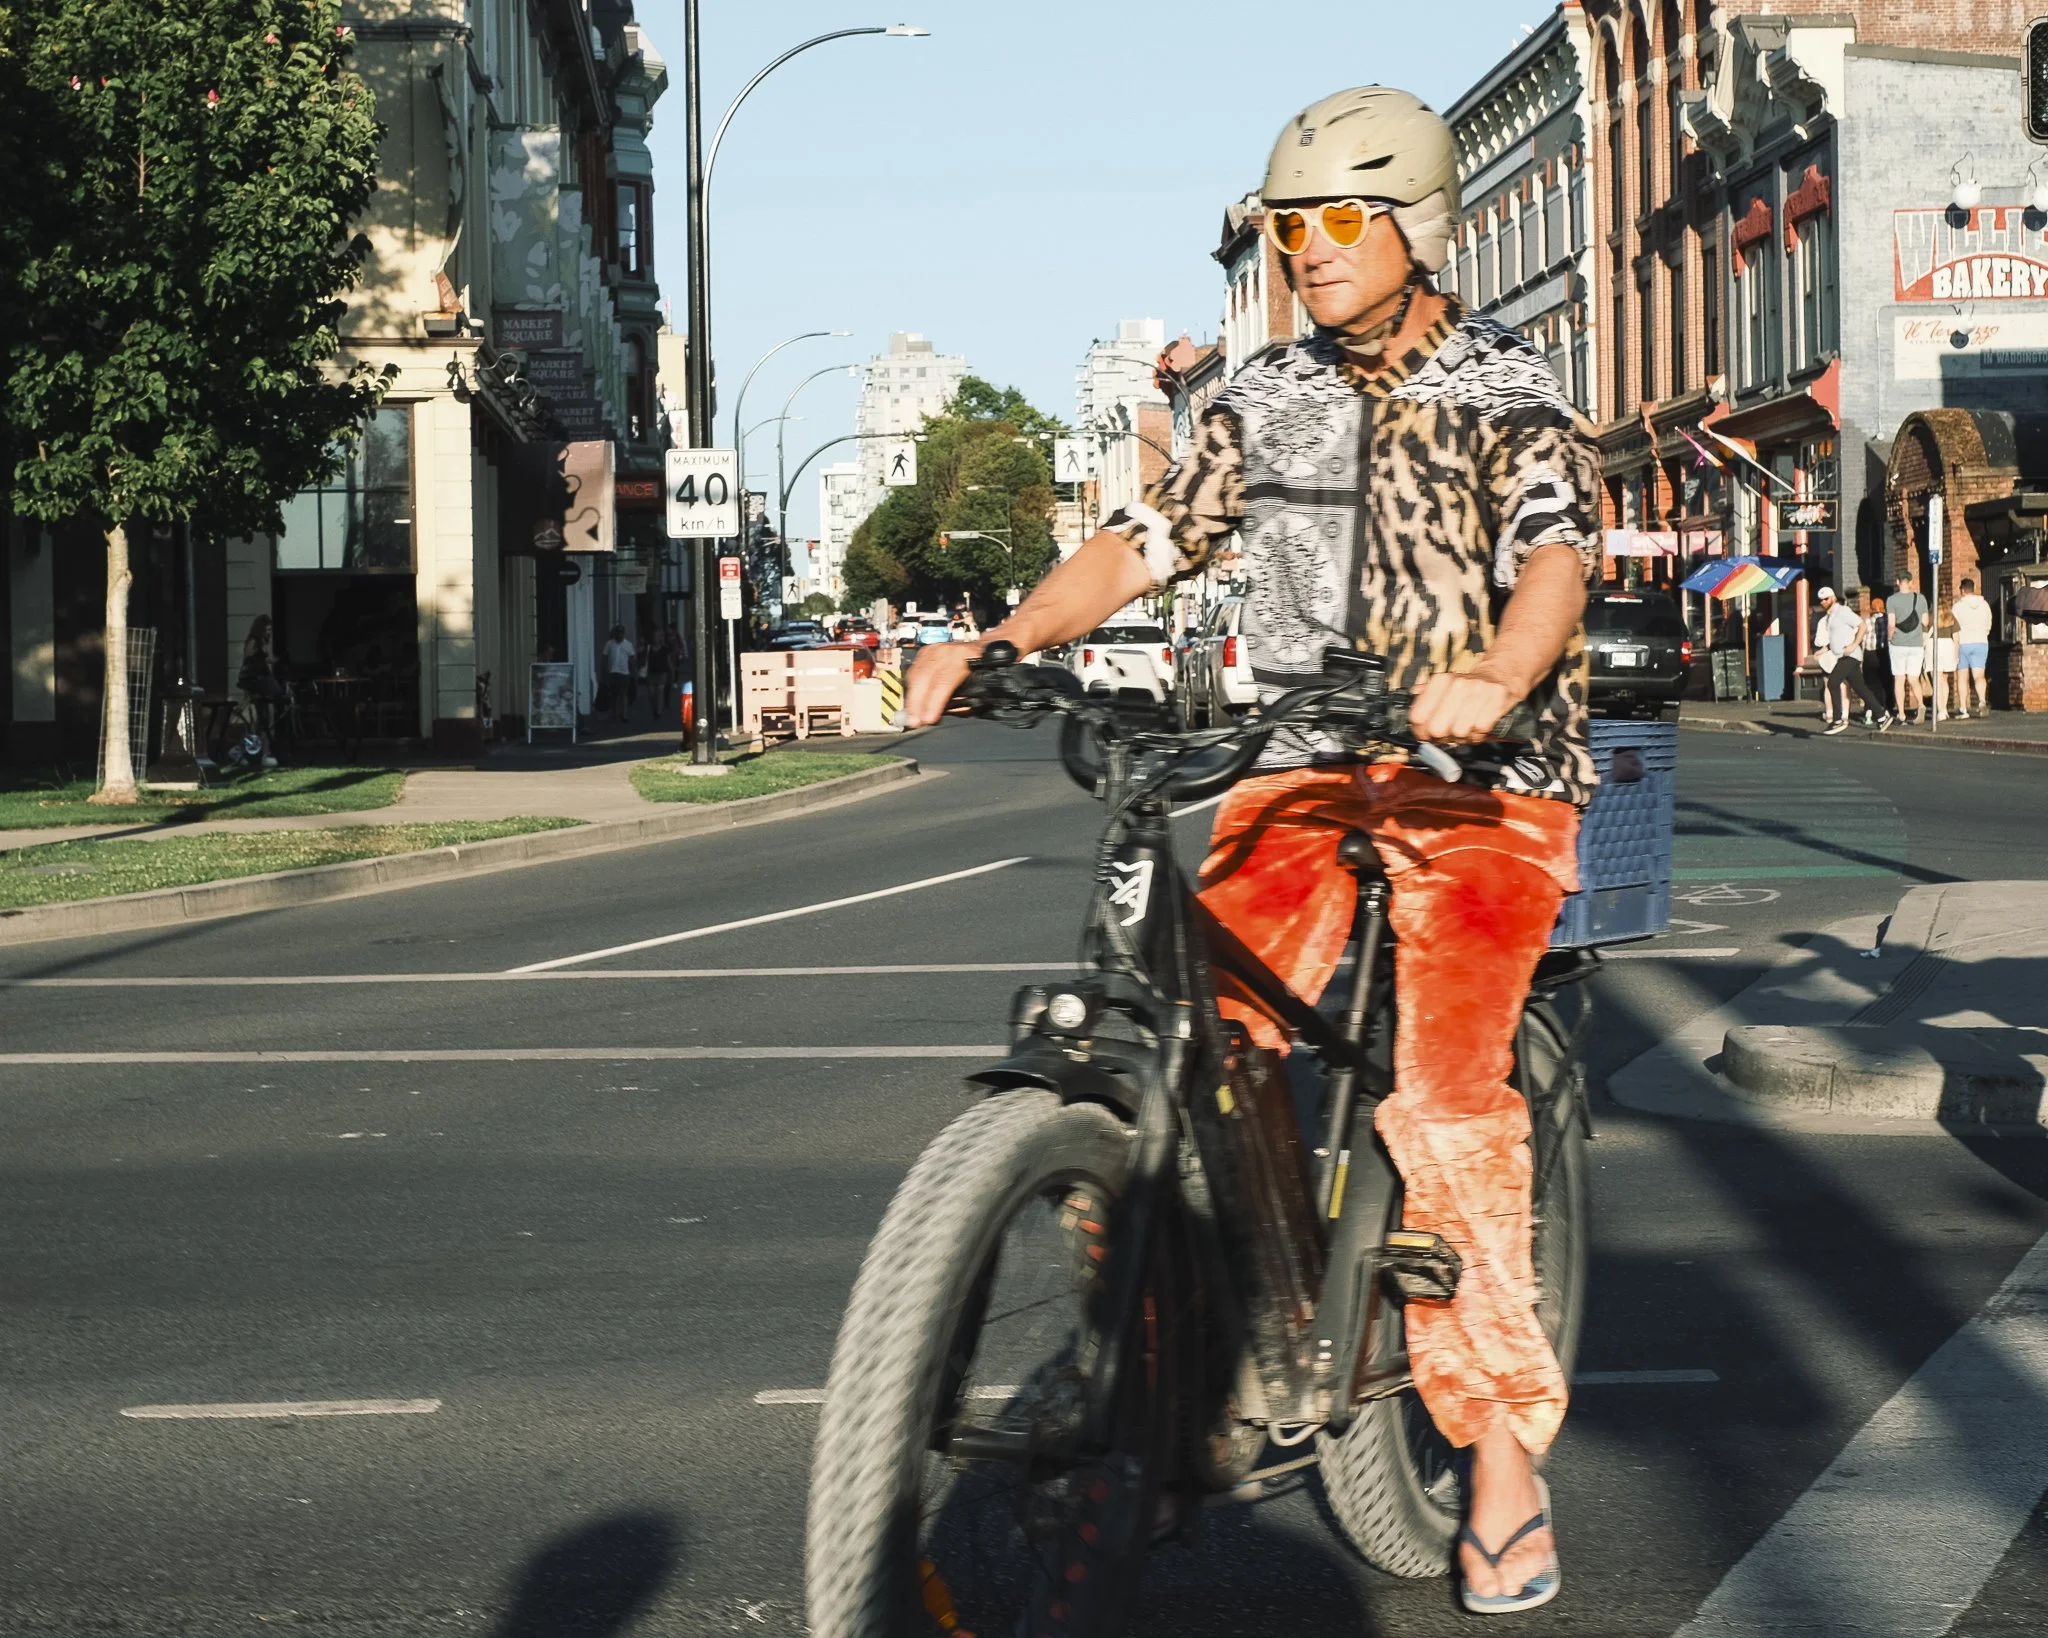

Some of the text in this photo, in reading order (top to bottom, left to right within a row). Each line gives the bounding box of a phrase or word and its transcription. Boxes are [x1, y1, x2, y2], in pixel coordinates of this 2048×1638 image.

[1932, 257, 2048, 298] BAKERY
[503, 319, 552, 329] MARKET
[502, 330, 553, 342] SQUARE
[1983, 351, 1992, 364] IN
[530, 360, 575, 369] MARKET
[673, 455, 730, 466] MAXIMUM
[675, 472, 729, 509] 40
[681, 517, 725, 531] km/h
